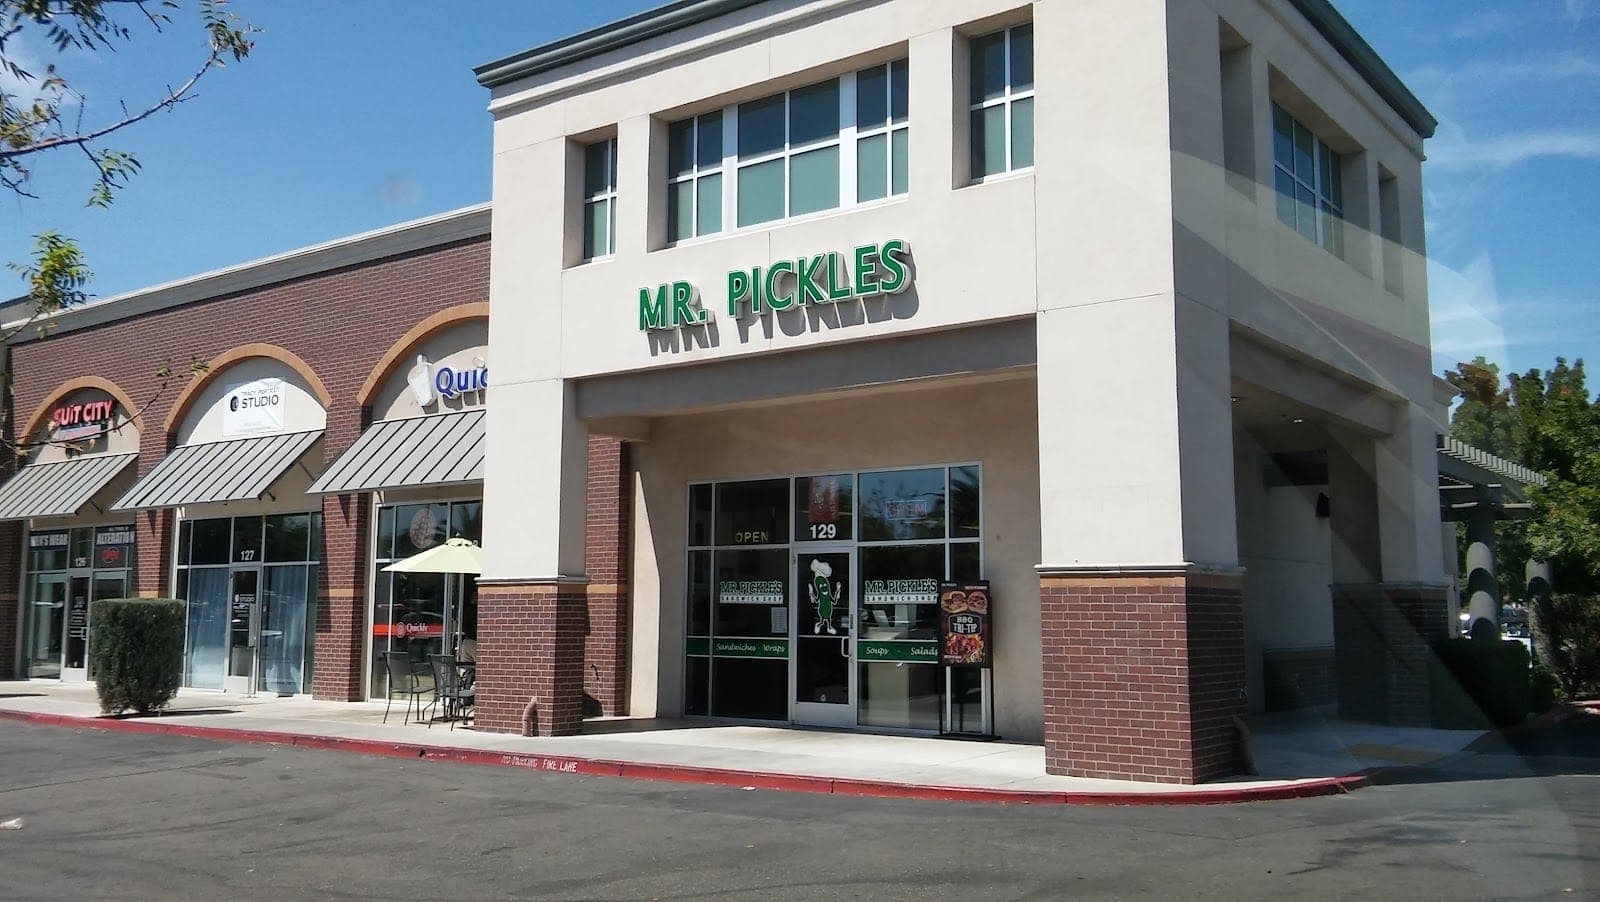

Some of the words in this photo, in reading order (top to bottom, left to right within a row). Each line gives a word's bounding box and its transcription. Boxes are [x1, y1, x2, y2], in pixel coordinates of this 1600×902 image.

[639, 280, 708, 331] MR.
[727, 239, 907, 318] PICKLES
[242, 394, 279, 409] STUDIO
[83, 400, 112, 422] CITY
[735, 531, 769, 543] OPEN
[809, 523, 837, 539] 129
[240, 550, 255, 562] 127
[720, 581, 740, 594] MR.
[740, 580, 783, 594] PICKLE'S
[865, 580, 887, 594] MR.
[887, 578, 938, 594] PICKLE'S
[957, 616, 974, 624] BBQ
[953, 623, 978, 634] TRI-TIP
[716, 643, 756, 653] Sandwiches
[763, 644, 785, 654] Wraps
[865, 646, 890, 656] Soups
[910, 646, 938, 656] Salads
[542, 758, 557, 770] FIRE
[559, 761, 578, 773] LANE
